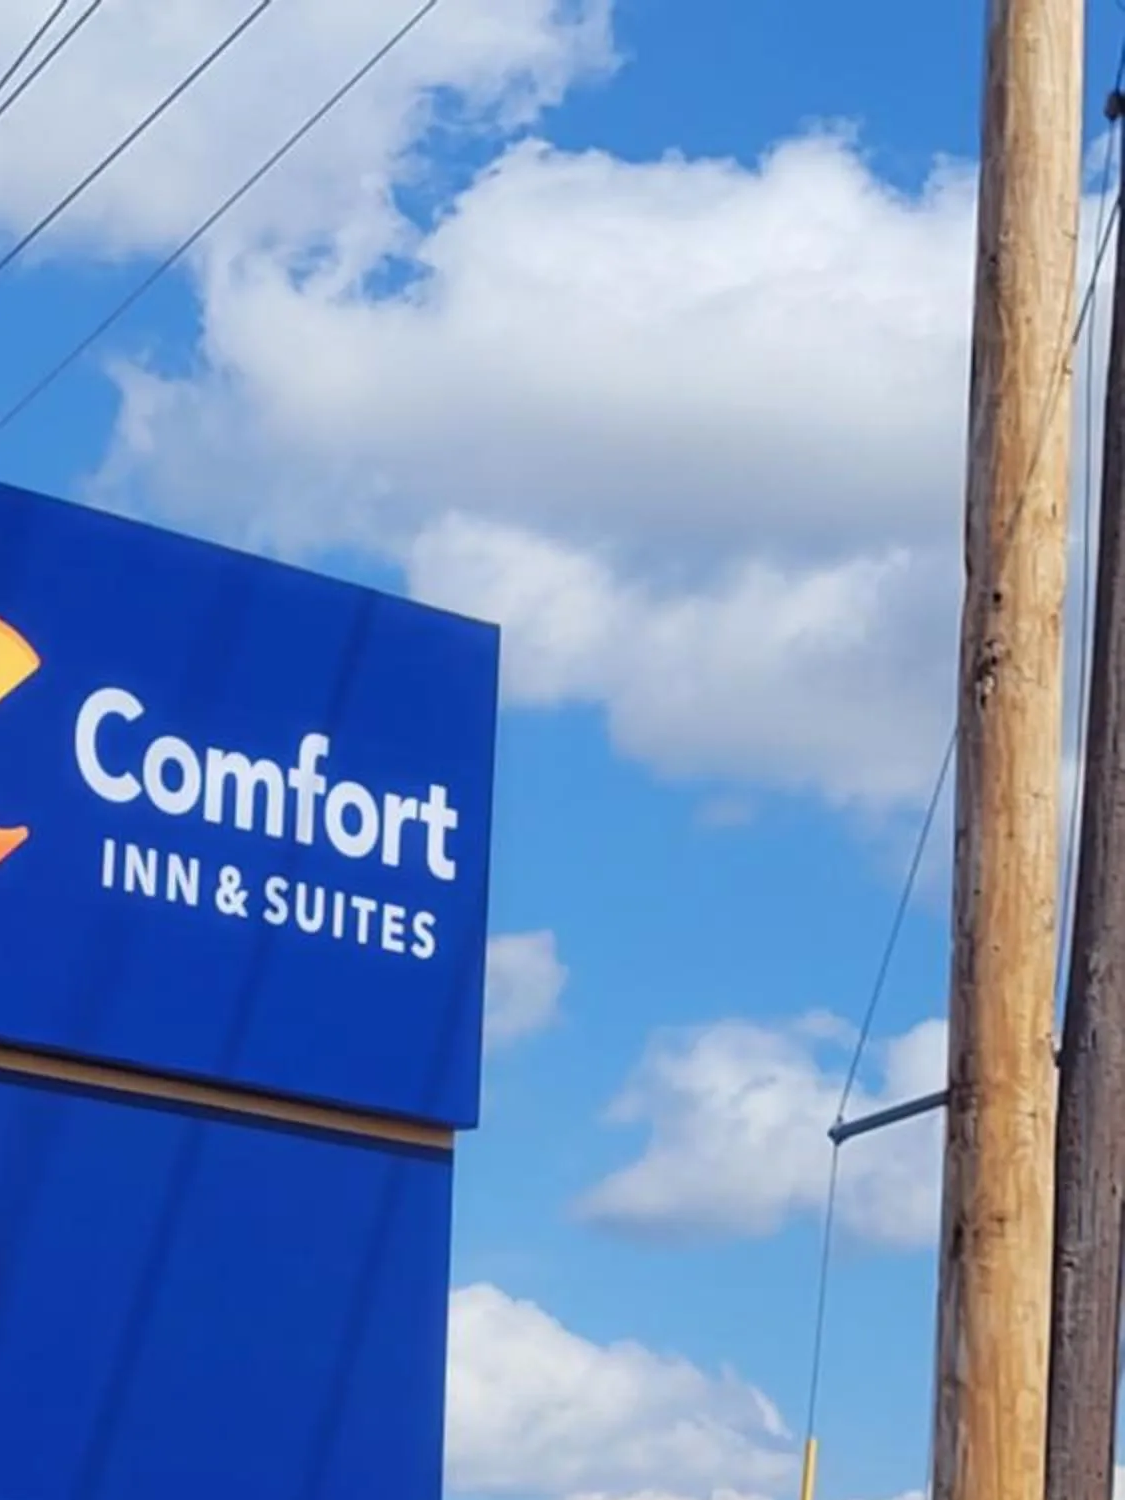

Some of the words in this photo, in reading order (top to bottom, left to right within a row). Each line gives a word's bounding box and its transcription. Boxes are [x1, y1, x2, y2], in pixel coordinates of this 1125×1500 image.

[76, 688, 458, 880] Comfort
[103, 840, 199, 904] INN
[216, 866, 248, 917] &
[265, 877, 435, 959] SUITES
